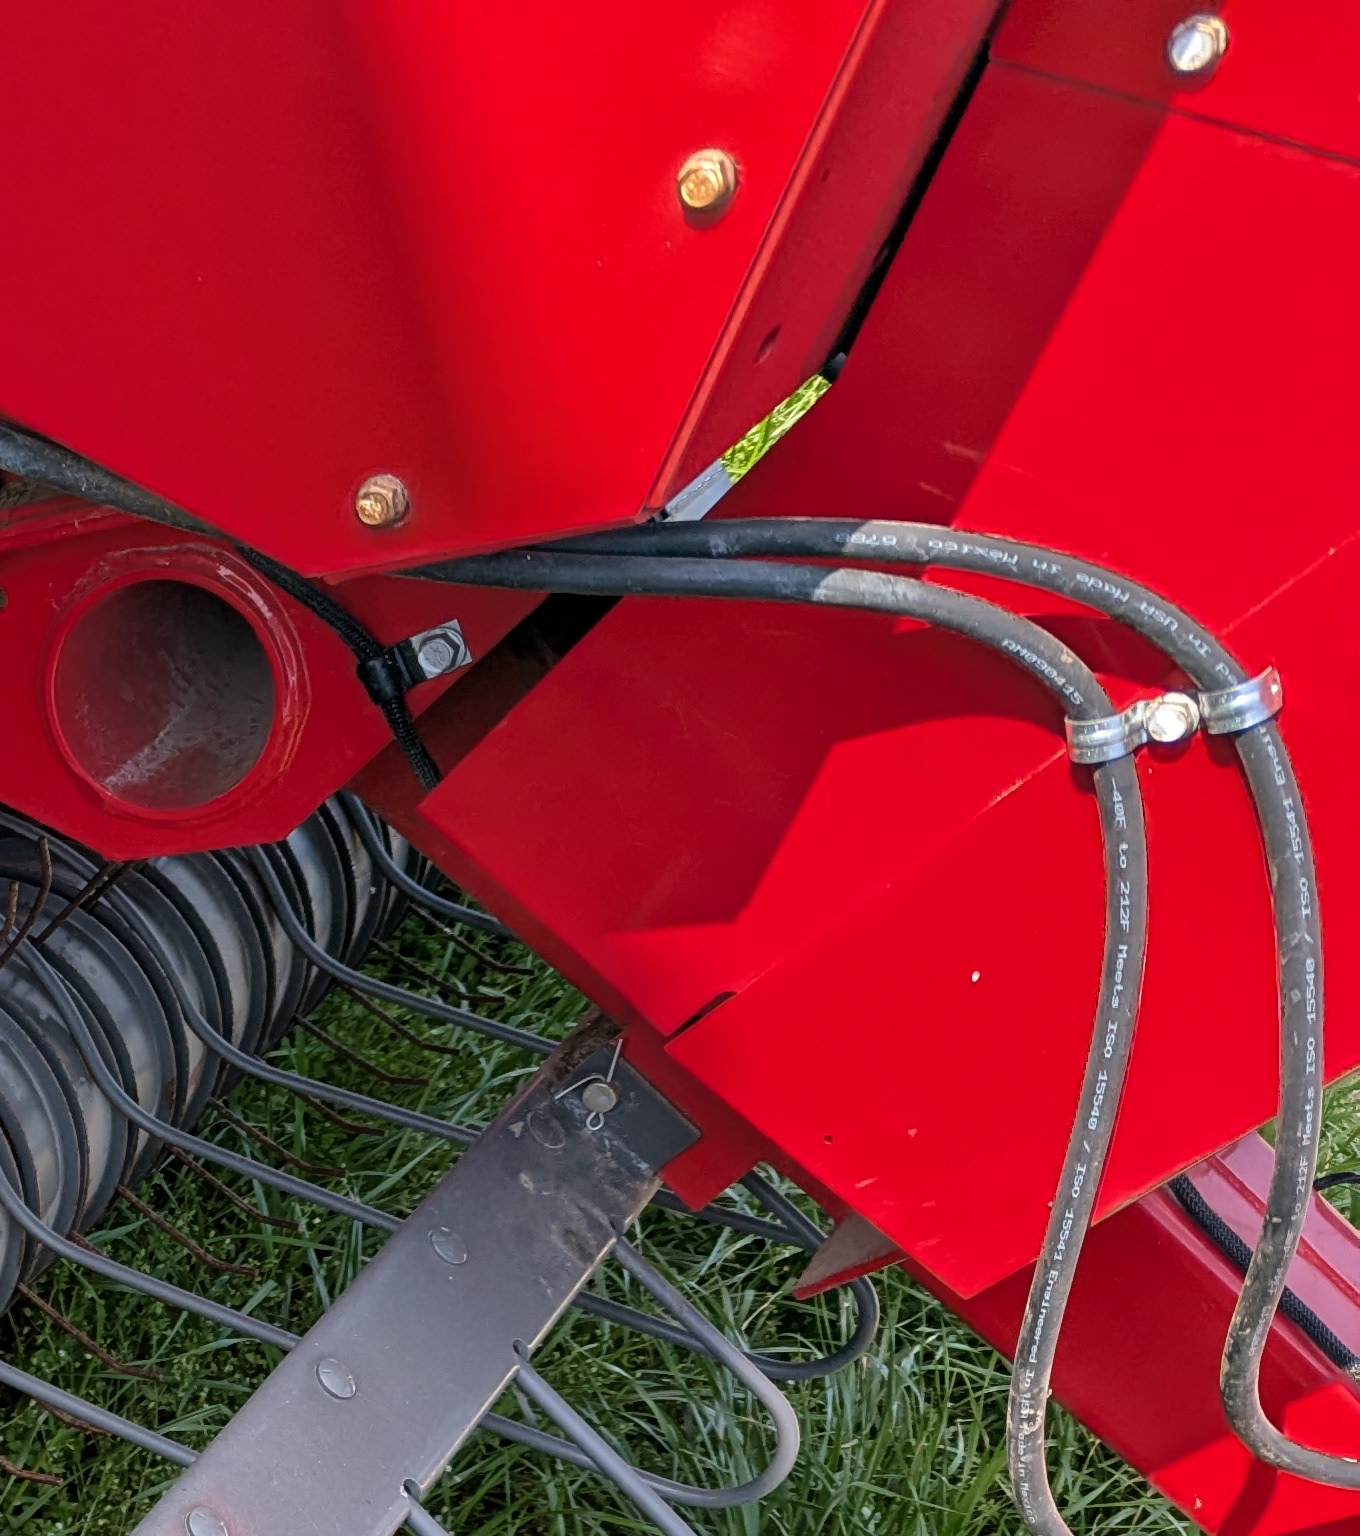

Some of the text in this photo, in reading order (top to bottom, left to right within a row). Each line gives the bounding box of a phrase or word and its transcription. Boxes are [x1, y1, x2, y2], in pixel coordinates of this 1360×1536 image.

[929, 539, 1018, 565] Mexico
[1076, 572, 1130, 603] Made
[1139, 601, 1179, 632] USA
[1001, 638, 1084, 705] AM090415
[1111, 777, 1127, 829] -40F
[1282, 797, 1305, 863] 15541
[1118, 841, 1129, 869] to
[1119, 881, 1131, 933] 212F
[1299, 877, 1312, 919] ISO
[1304, 932, 1314, 945] /
[1111, 944, 1128, 1009] Meets
[1305, 957, 1317, 1025] 15540
[1103, 1020, 1119, 1059] ISO
[1306, 1036, 1316, 1076] ISO
[1087, 1069, 1108, 1131] 15540
[1301, 1087, 1315, 1146] Meets
[1083, 1140, 1091, 1153] /
[1071, 1163, 1087, 1198] ISO
[1296, 1155, 1309, 1195] 212F
[1053, 1207, 1074, 1261] 15541
[1029, 1269, 1059, 1363] Engineered
[1024, 1369, 1035, 1387] In
[1020, 1482, 1036, 1524] Mexico
